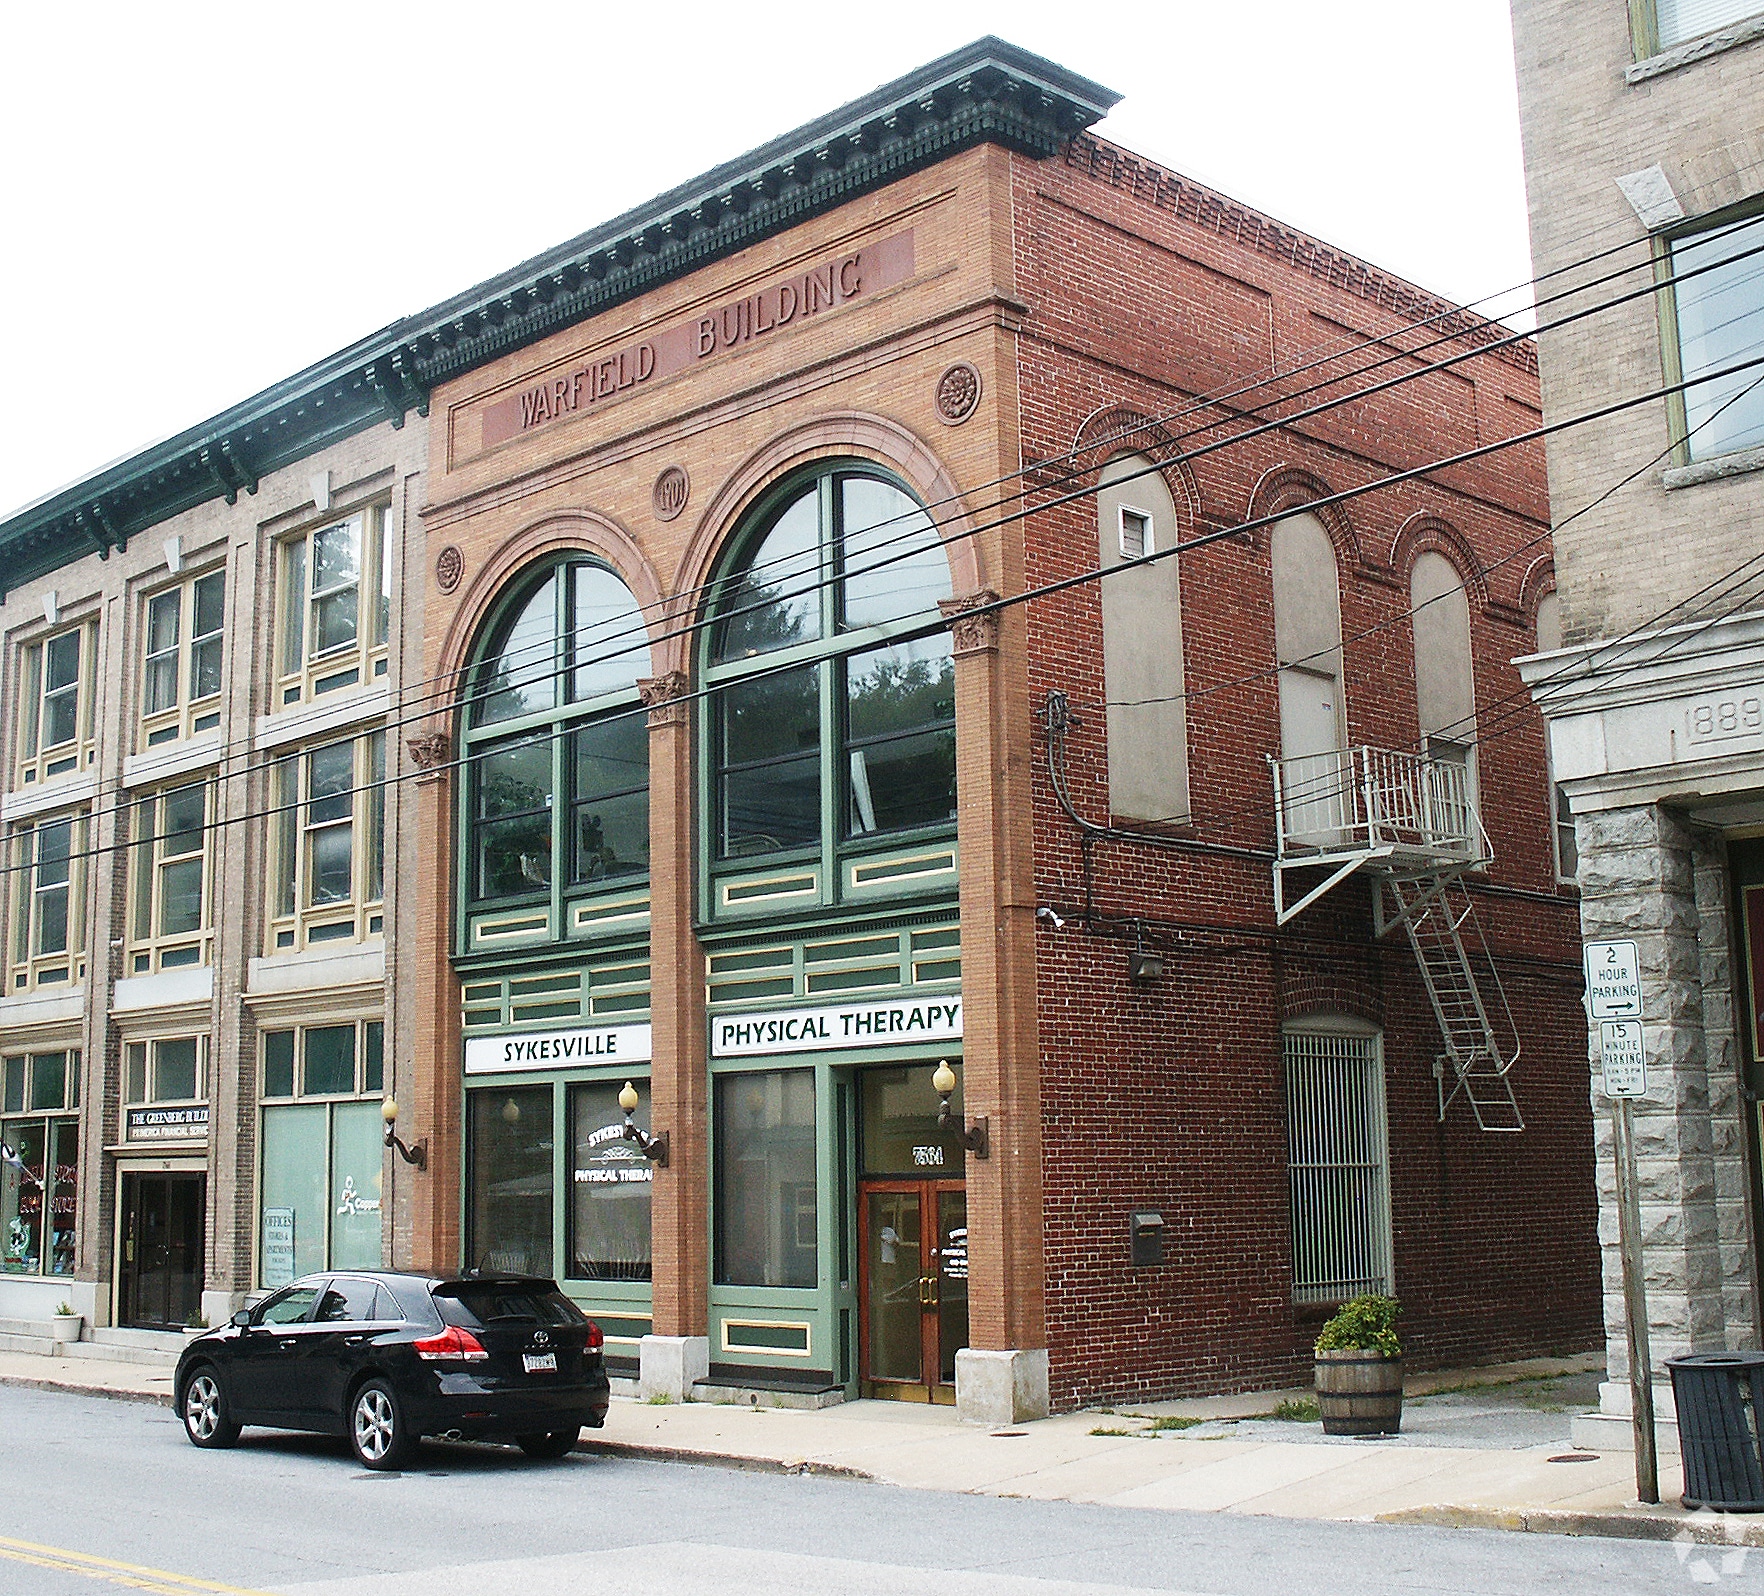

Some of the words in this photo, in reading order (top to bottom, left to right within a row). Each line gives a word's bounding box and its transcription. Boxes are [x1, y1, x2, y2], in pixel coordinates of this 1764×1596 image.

[519, 342, 656, 429] WARFIELD
[697, 254, 862, 359] BUILDING
[659, 478, 686, 512] 1901
[1684, 697, 1763, 738] 1889
[1606, 946, 1617, 963] 2
[1598, 967, 1628, 981] HOUR
[1592, 984, 1637, 998] PARKING
[722, 1016, 830, 1047] PHYSICAL
[840, 1004, 960, 1036] THERAPY
[1611, 1024, 1627, 1038] 15
[504, 1034, 617, 1062] SYKESVILLE
[1604, 1040, 1637, 1051] MINUTE
[1604, 1052, 1641, 1065] PARKING
[131, 1113, 146, 1125] THE
[574, 1169, 618, 1182] PHYSICAL
[619, 1168, 654, 1182] THERA
[265, 1215, 292, 1227] OFFICES
